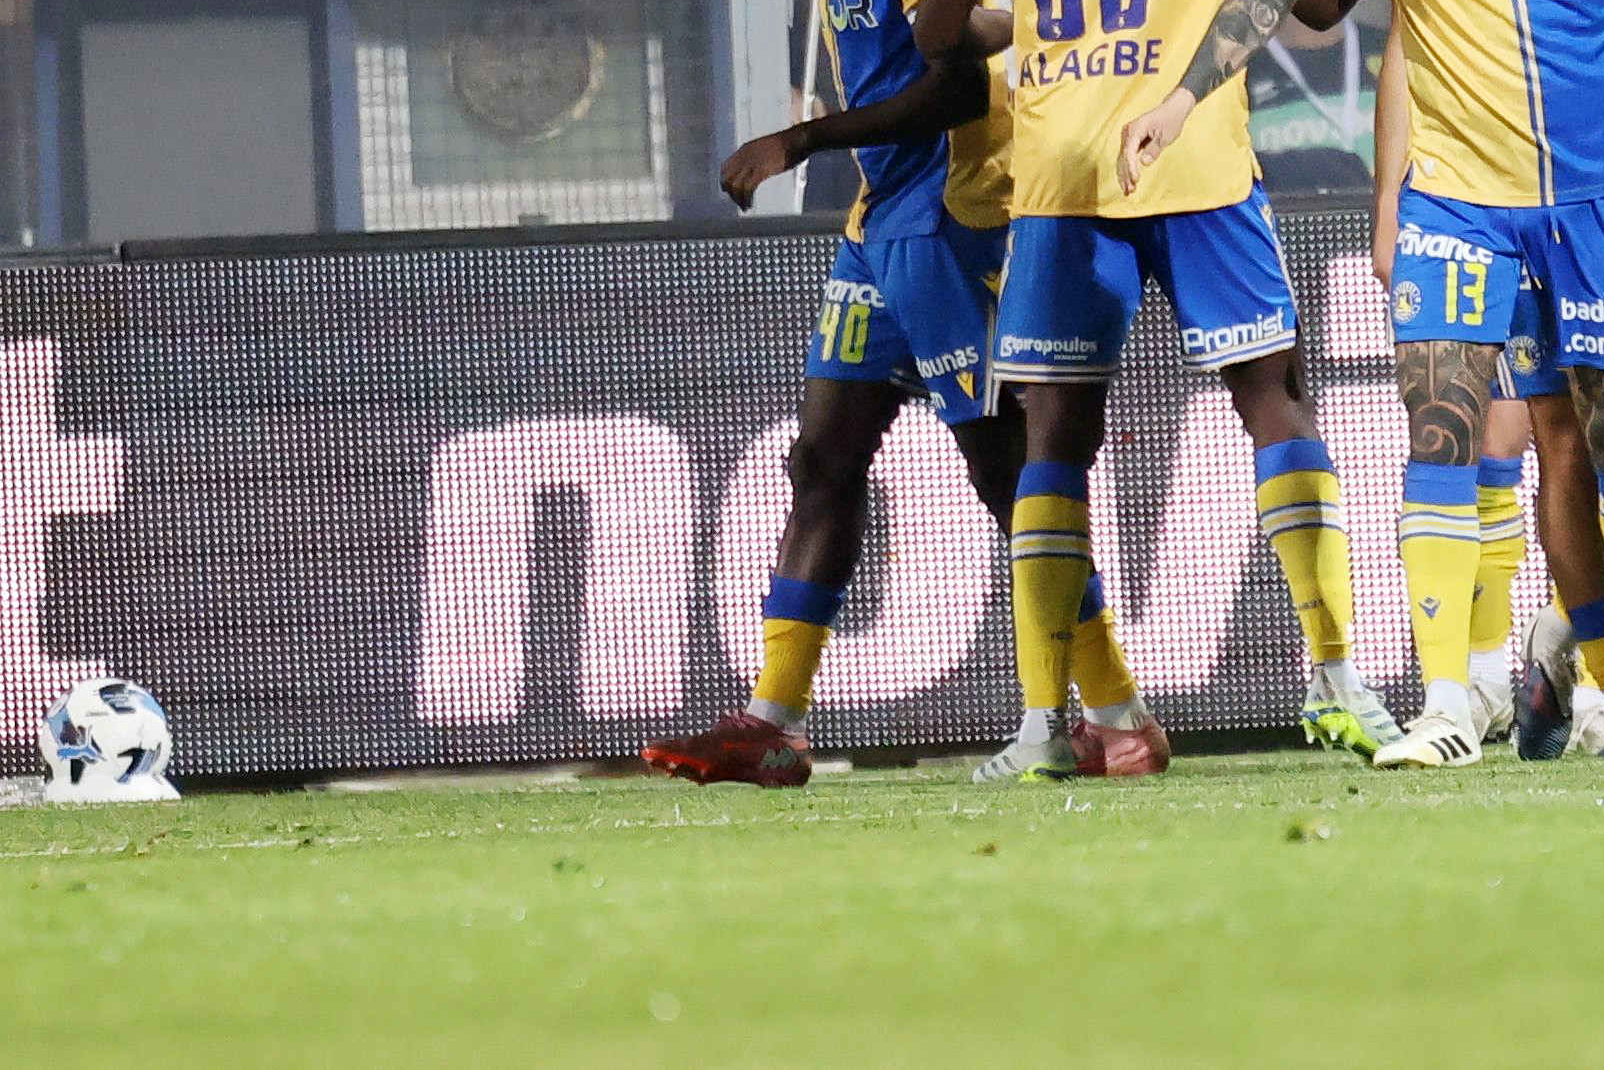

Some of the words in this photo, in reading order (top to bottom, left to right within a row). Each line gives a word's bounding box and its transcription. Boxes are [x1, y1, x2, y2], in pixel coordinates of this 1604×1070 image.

[1018, 39, 1163, 88] ALAGBE
[1445, 261, 1487, 326] 13
[819, 303, 871, 364] 40
[1182, 307, 1284, 355] Promist
